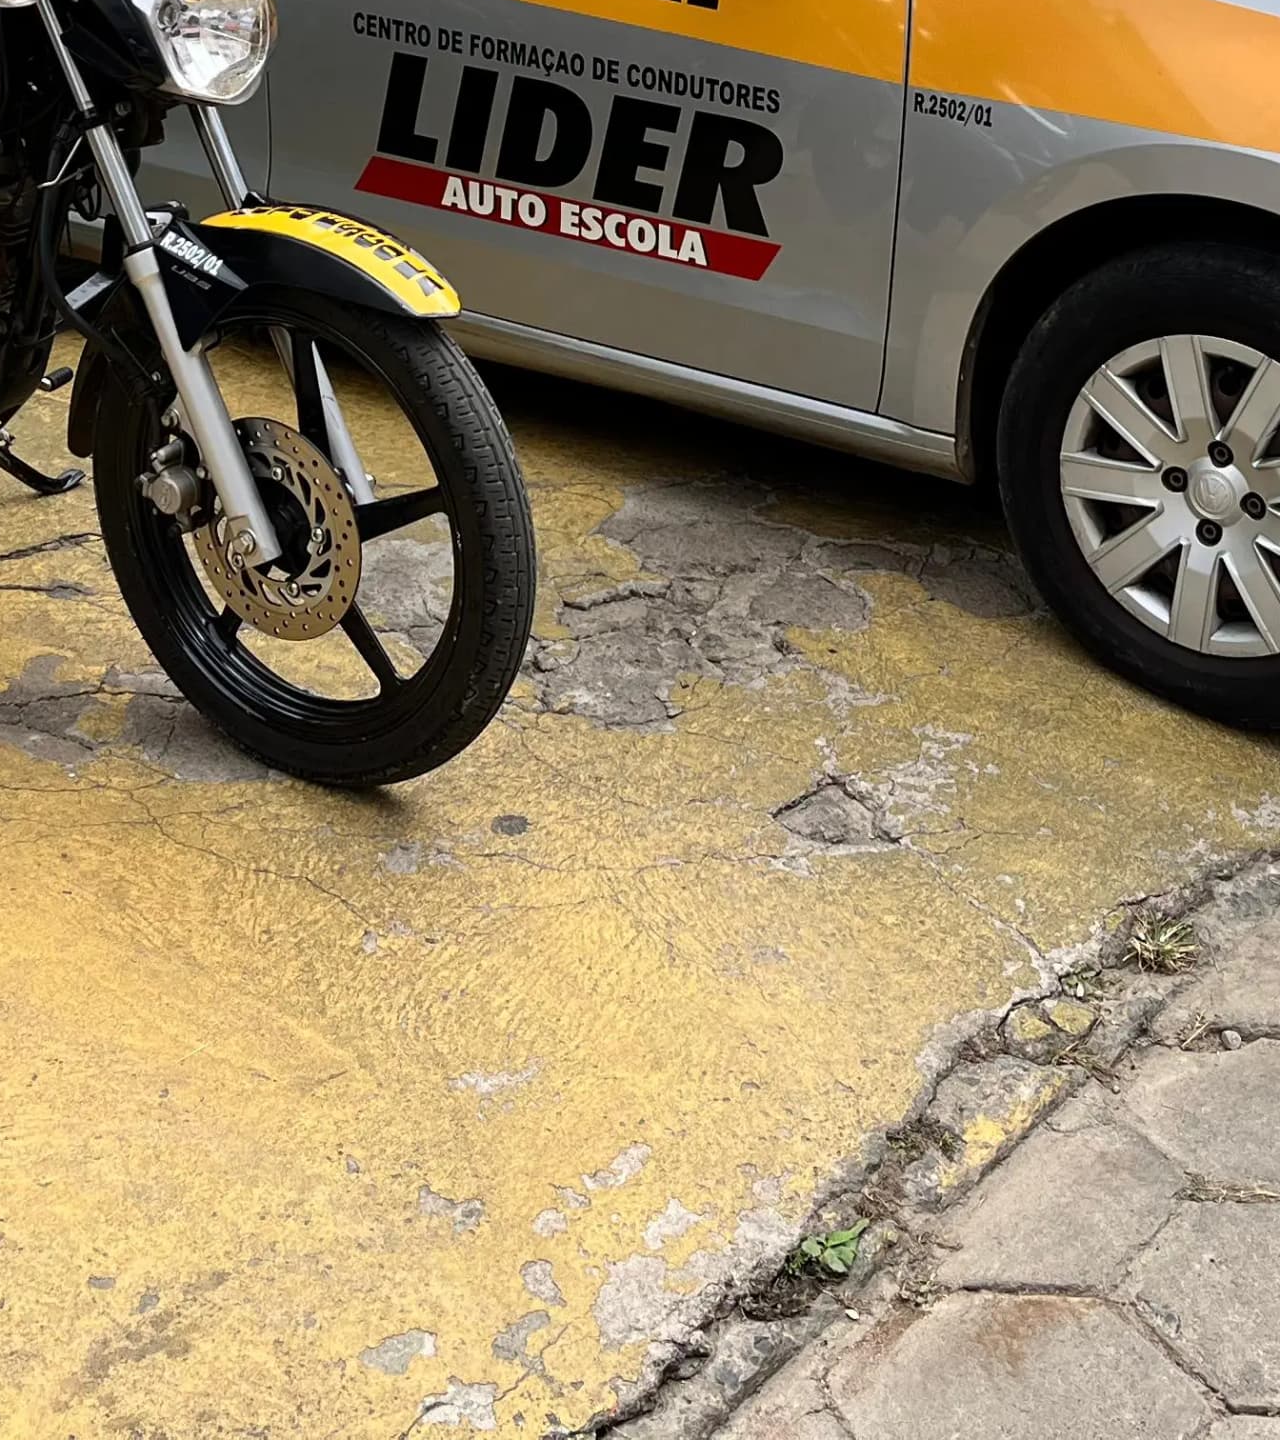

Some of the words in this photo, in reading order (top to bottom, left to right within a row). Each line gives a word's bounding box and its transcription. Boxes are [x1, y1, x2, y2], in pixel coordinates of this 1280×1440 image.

[352, 11, 431, 48] CENTRO
[437, 25, 463, 53] DE
[469, 33, 585, 77] FORMAÇAO
[592, 57, 620, 84] DE
[626, 63, 781, 114] CONDUTORES
[376, 51, 785, 238] LIDER
[913, 91, 993, 128] R.2502/01
[160, 231, 224, 276] R.2502/01
[441, 176, 547, 227] AUTO
[560, 201, 708, 266] ESCOLA
